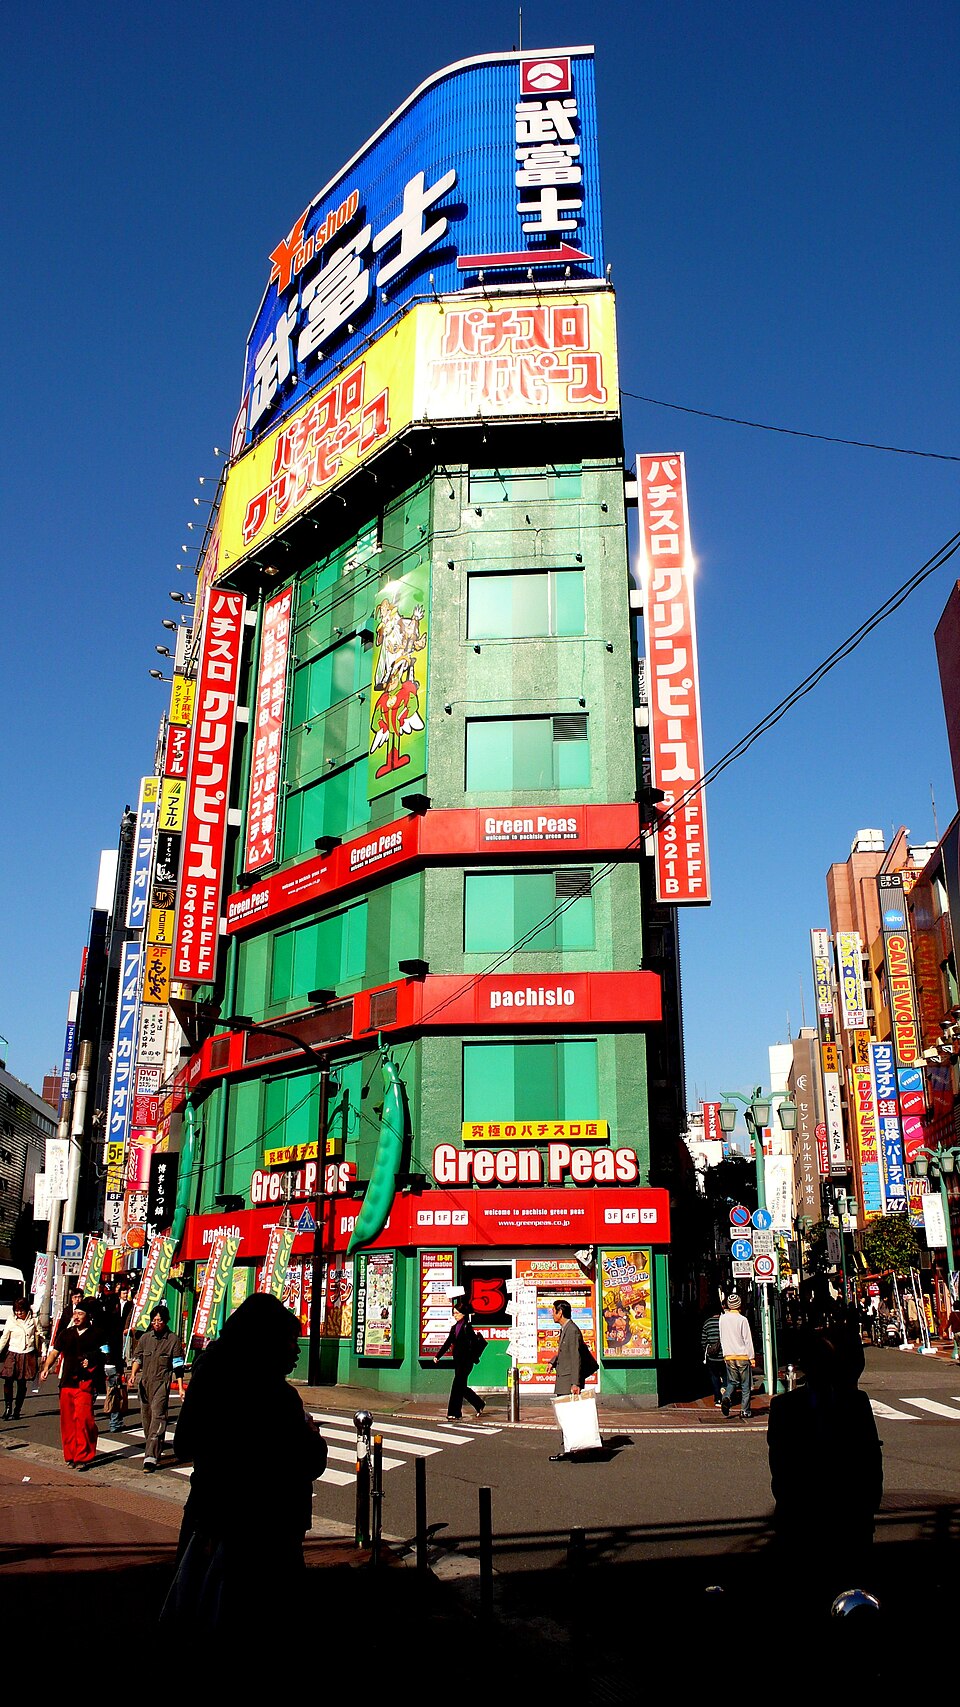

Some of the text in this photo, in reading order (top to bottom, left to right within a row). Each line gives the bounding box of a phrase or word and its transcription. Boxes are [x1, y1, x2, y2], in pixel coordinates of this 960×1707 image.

[515, 98, 583, 233] 武富士
[314, 189, 360, 253] shop
[249, 169, 458, 432] 武富士
[441, 304, 590, 357] パチスロ
[270, 361, 367, 482] パチスロ
[646, 458, 680, 556] パチスロ
[188, 594, 241, 881] パチスロ グリンピース
[165, 796, 180, 828] アエル
[485, 816, 577, 834] Green Peas
[350, 830, 403, 865] Green Peas
[664, 842, 700, 859] 2F
[132, 811, 155, 918] カラオケ
[665, 860, 701, 877] 1F
[892, 876, 901, 885] 3
[185, 884, 215, 900] 5F
[228, 889, 269, 917] Green Peas
[184, 898, 214, 914] 4F
[182, 915, 212, 931] 3F
[181, 930, 211, 946] 2F
[152, 948, 167, 957] 2F
[180, 945, 210, 961] 1F
[179, 959, 210, 974] BF
[490, 986, 575, 1009] pachislo
[887, 934, 918, 1063] GAME WORLD
[874, 1046, 895, 1098] カラオケ
[903, 1073, 920, 1086] VIDEO
[878, 1100, 897, 1116] 全室
[904, 1095, 921, 1109] MEDAL
[471, 1123, 598, 1138] 究極のパチスロ店
[108, 1144, 123, 1161] 5F
[269, 1141, 331, 1163] 究極のパチス店
[433, 1142, 639, 1184] Green Peas
[799, 1102, 815, 1205] セントラルホテル東京
[154, 1163, 167, 1216] 博多もつ鍋
[304, 1162, 350, 1196] Pas
[484, 1208, 511, 1216] welcome
[521, 1208, 548, 1216] pachislo
[550, 1208, 568, 1216] green
[886, 1199, 906, 1211] 747
[610, 1266, 636, 1278] ロック
[759, 1260, 771, 1271] 30
[357, 1288, 367, 1323] Green
[356, 1324, 365, 1353] Peas
